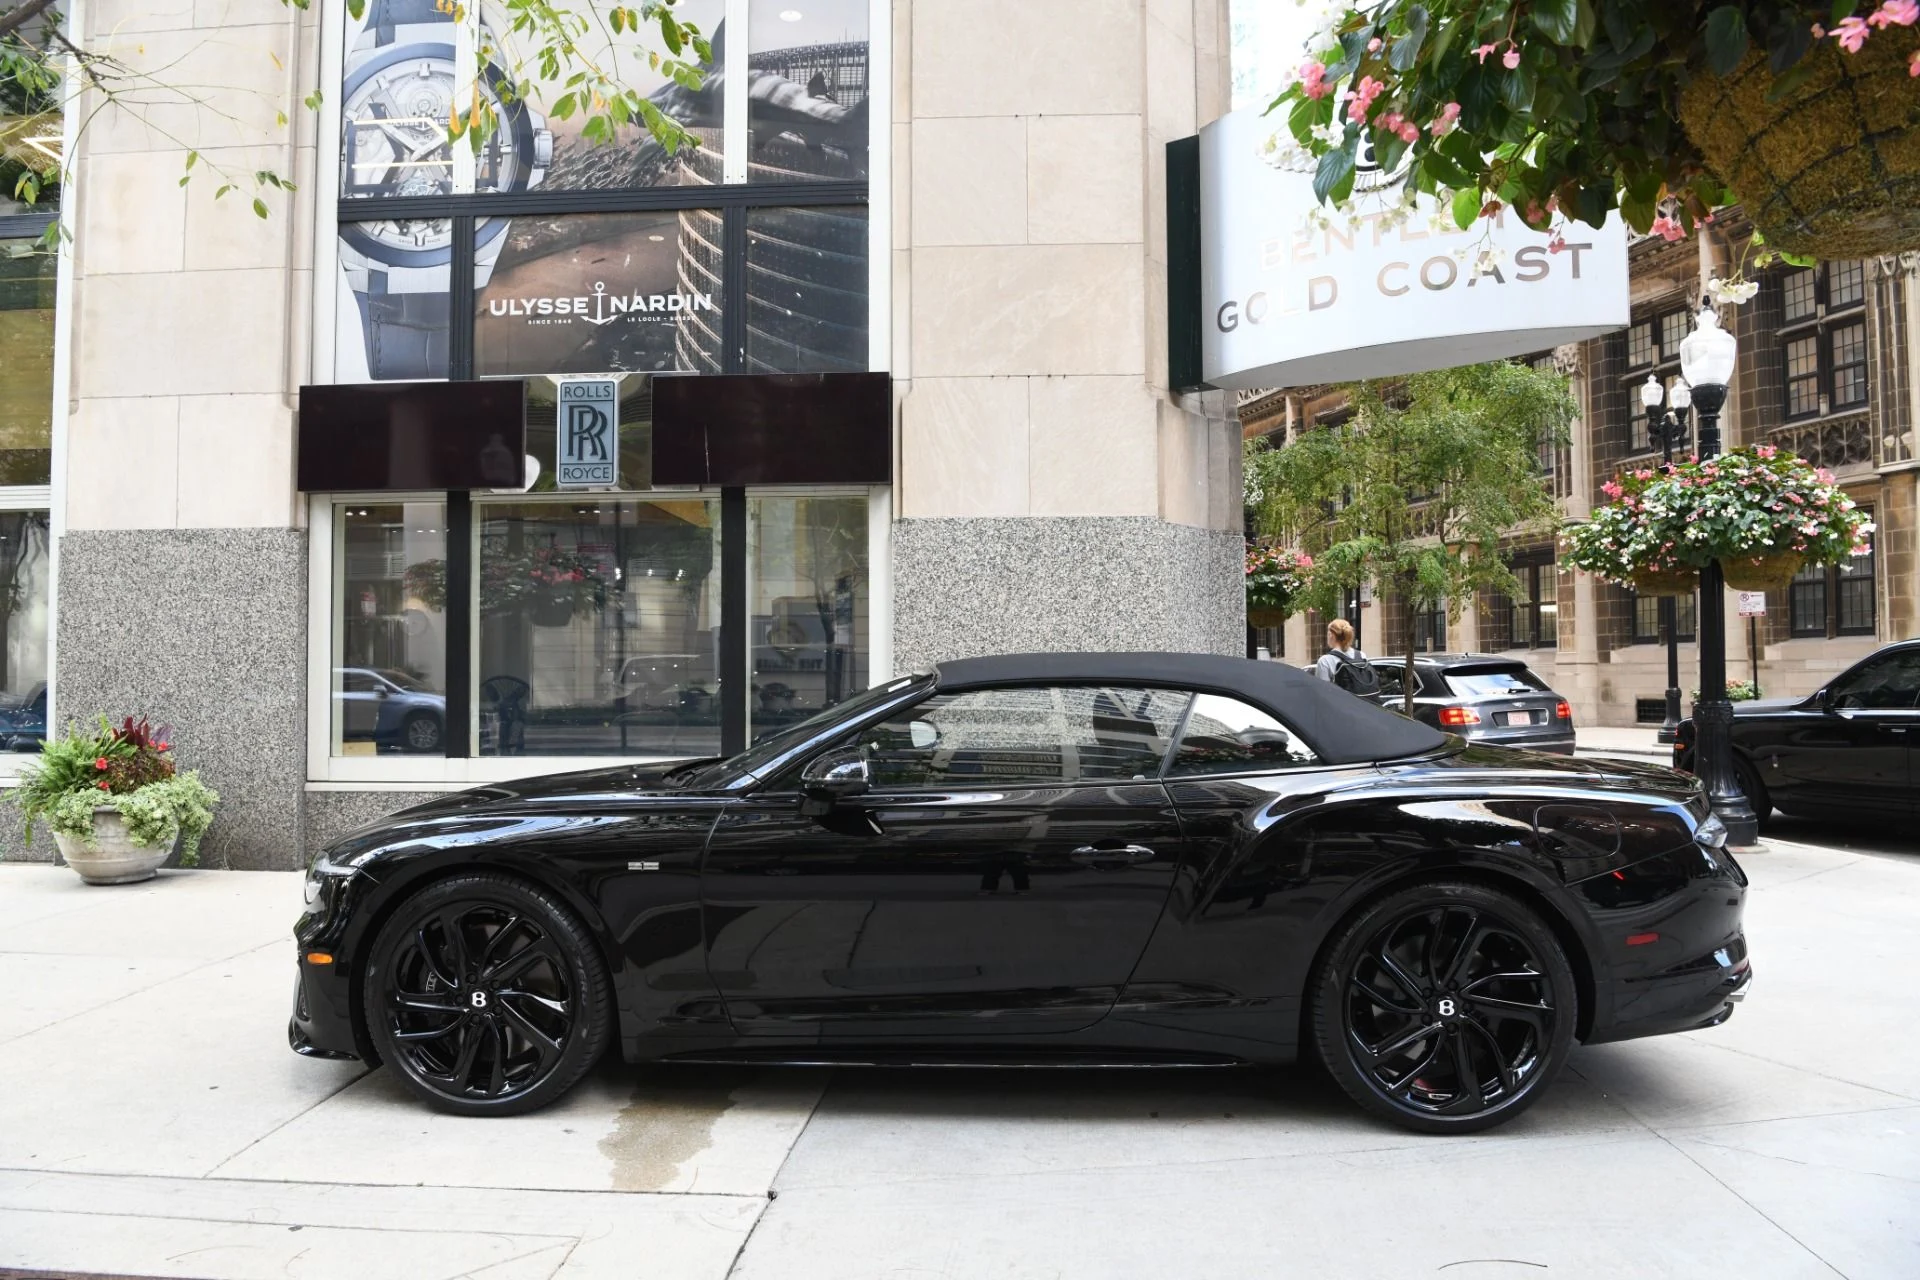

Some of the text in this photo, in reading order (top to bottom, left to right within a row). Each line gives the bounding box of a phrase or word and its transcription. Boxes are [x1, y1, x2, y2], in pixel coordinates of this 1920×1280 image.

[1260, 202, 1506, 270] BENTL
[1376, 242, 1593, 297] COAST
[490, 293, 711, 316] ULYSSE NARDIN
[564, 386, 611, 398] ROLLS
[563, 467, 610, 479] ROYCE
[471, 991, 487, 1008] B
[1438, 999, 1455, 1016] B
